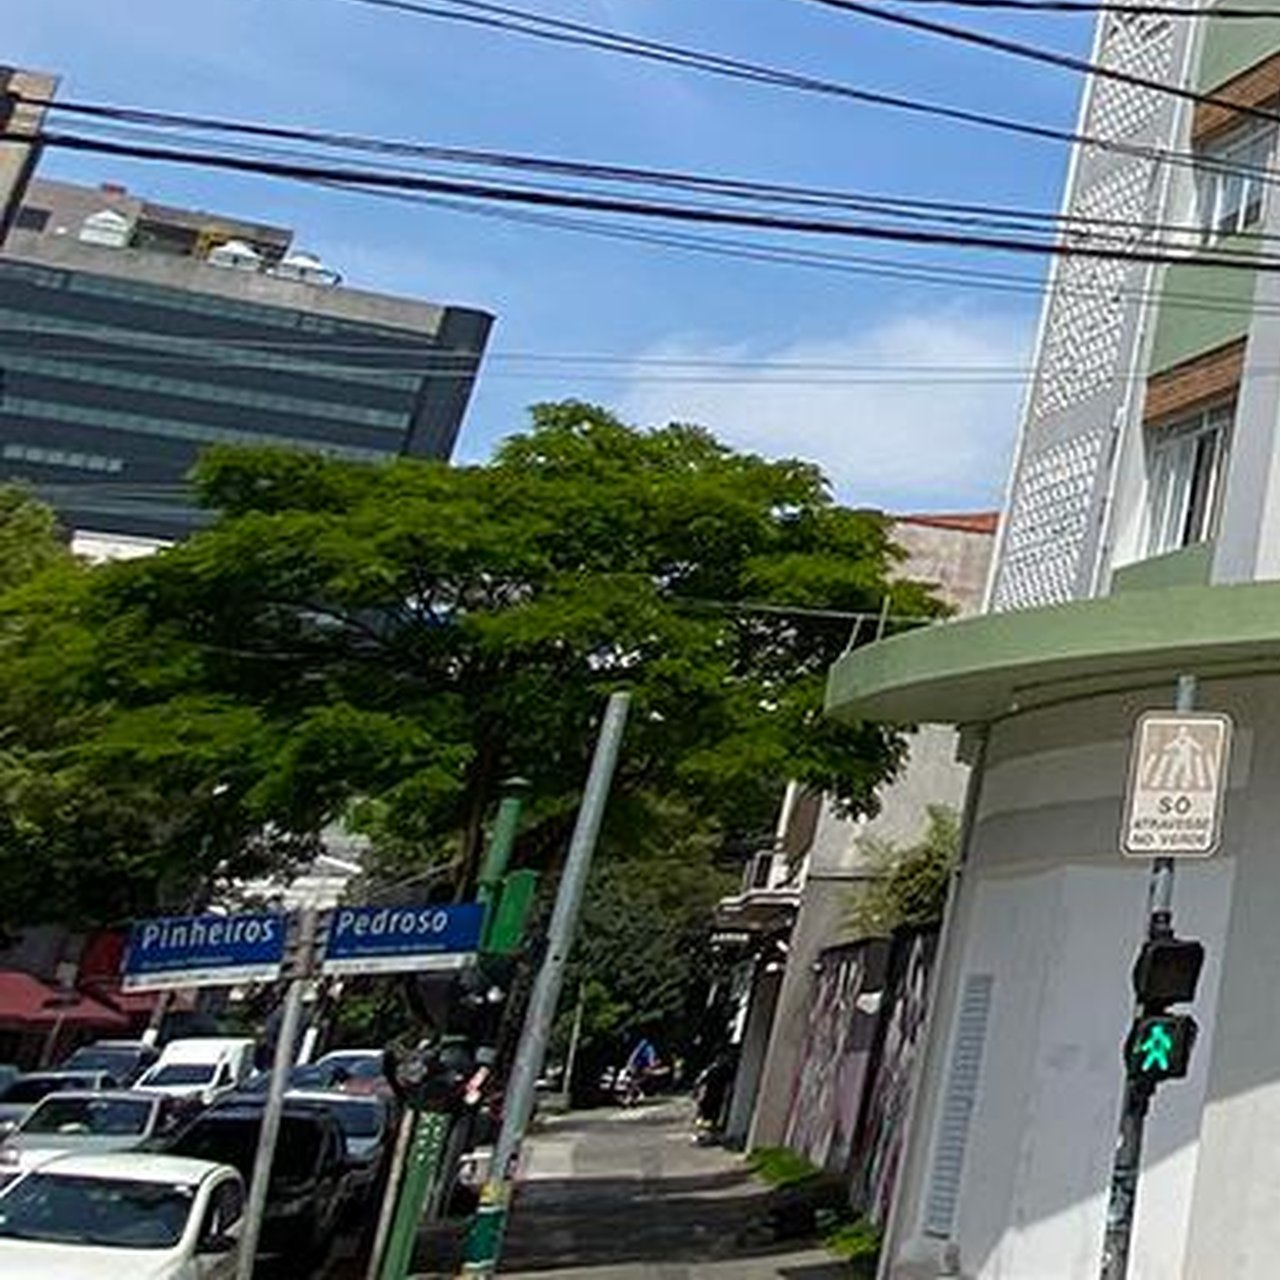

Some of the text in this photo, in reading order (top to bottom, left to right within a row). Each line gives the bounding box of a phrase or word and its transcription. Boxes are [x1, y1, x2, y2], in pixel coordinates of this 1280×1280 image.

[1131, 832, 1154, 847] NO
[141, 918, 275, 951] Pinheiros
[335, 908, 449, 937] Pedroso
